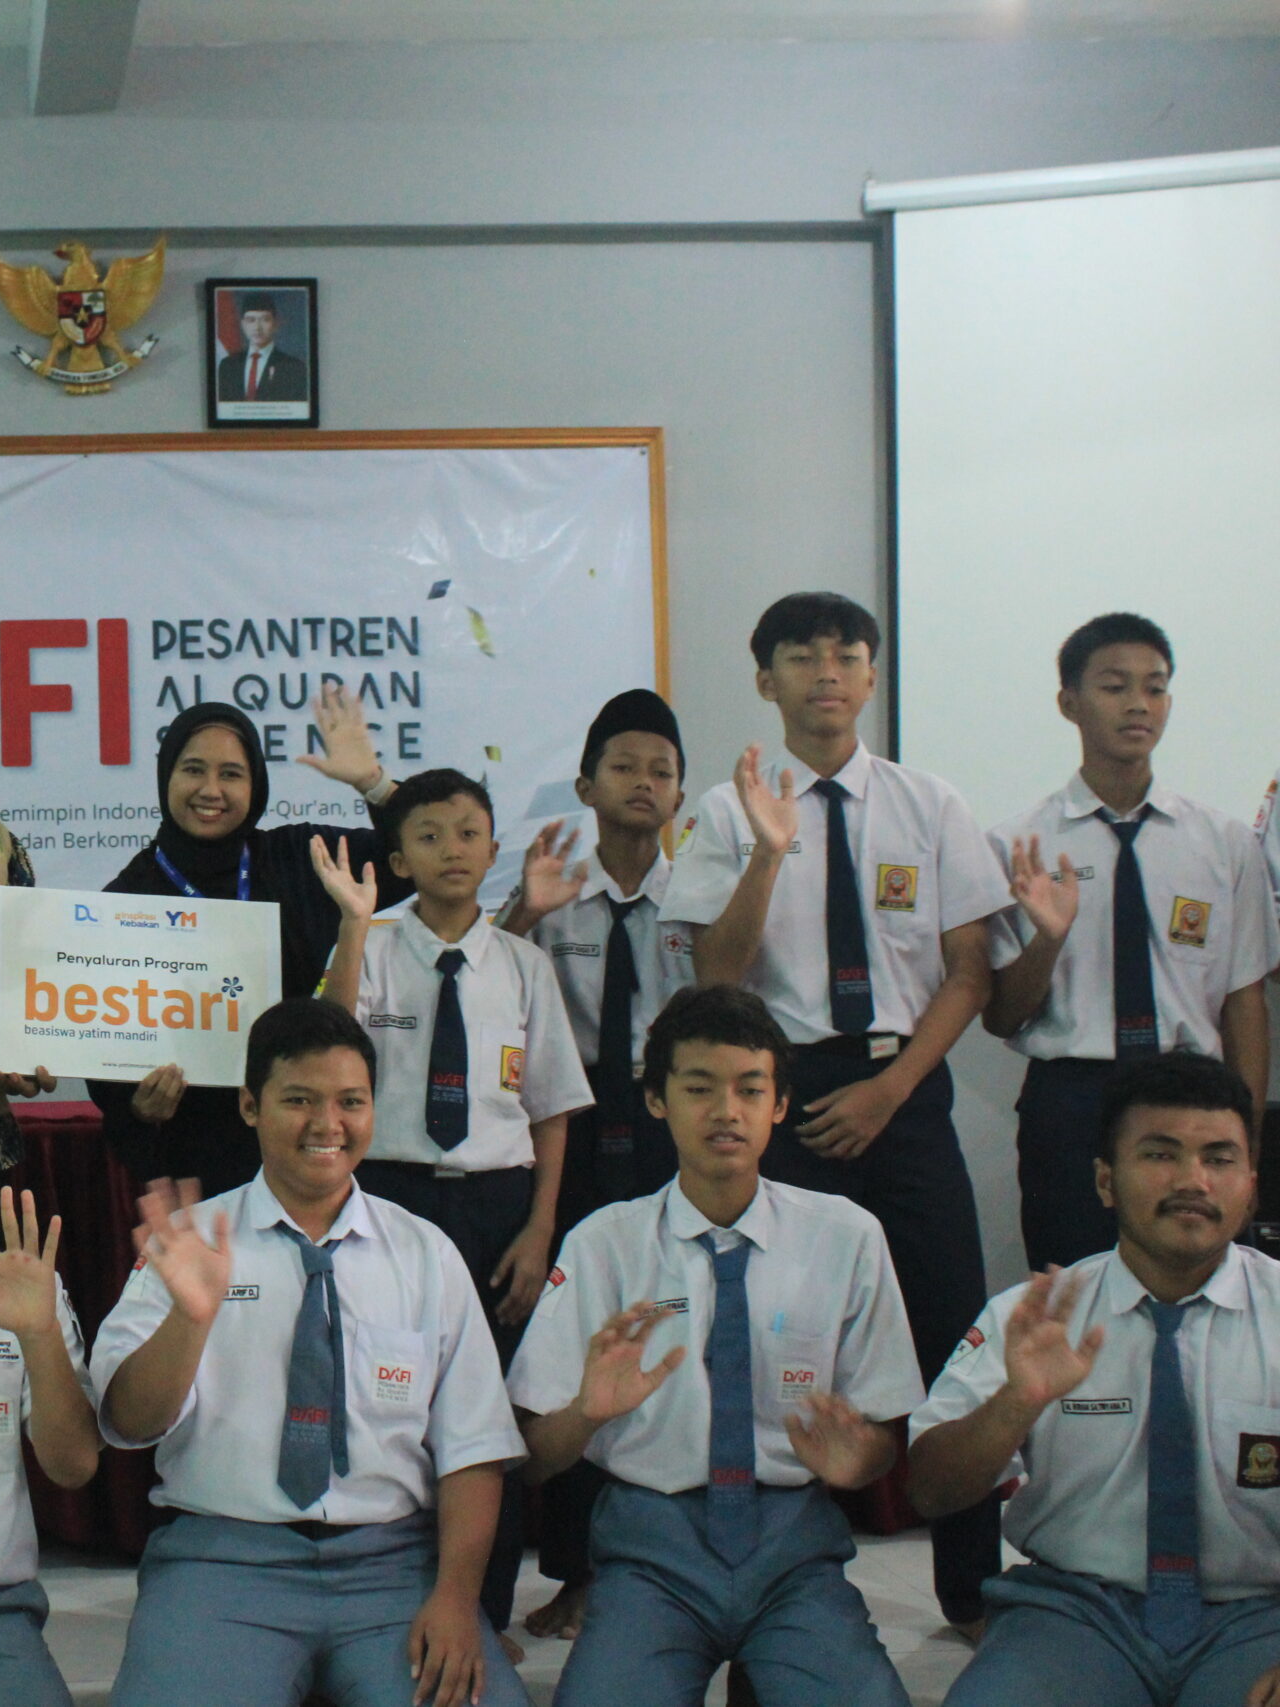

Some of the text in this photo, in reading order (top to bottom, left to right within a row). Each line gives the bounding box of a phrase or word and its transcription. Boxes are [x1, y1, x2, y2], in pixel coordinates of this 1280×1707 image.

[152, 616, 419, 659] PESANTREN
[93, 803, 162, 820] Indone
[63, 831, 152, 853] Berkomp
[165, 910, 198, 928] YM
[56, 951, 209, 974] Penyaluran Program
[24, 967, 239, 1033] bestari
[24, 1023, 158, 1043] beasiswa yatim mandiri
[378, 1366, 411, 1384] DAFI
[783, 1369, 815, 1383] DAFI
